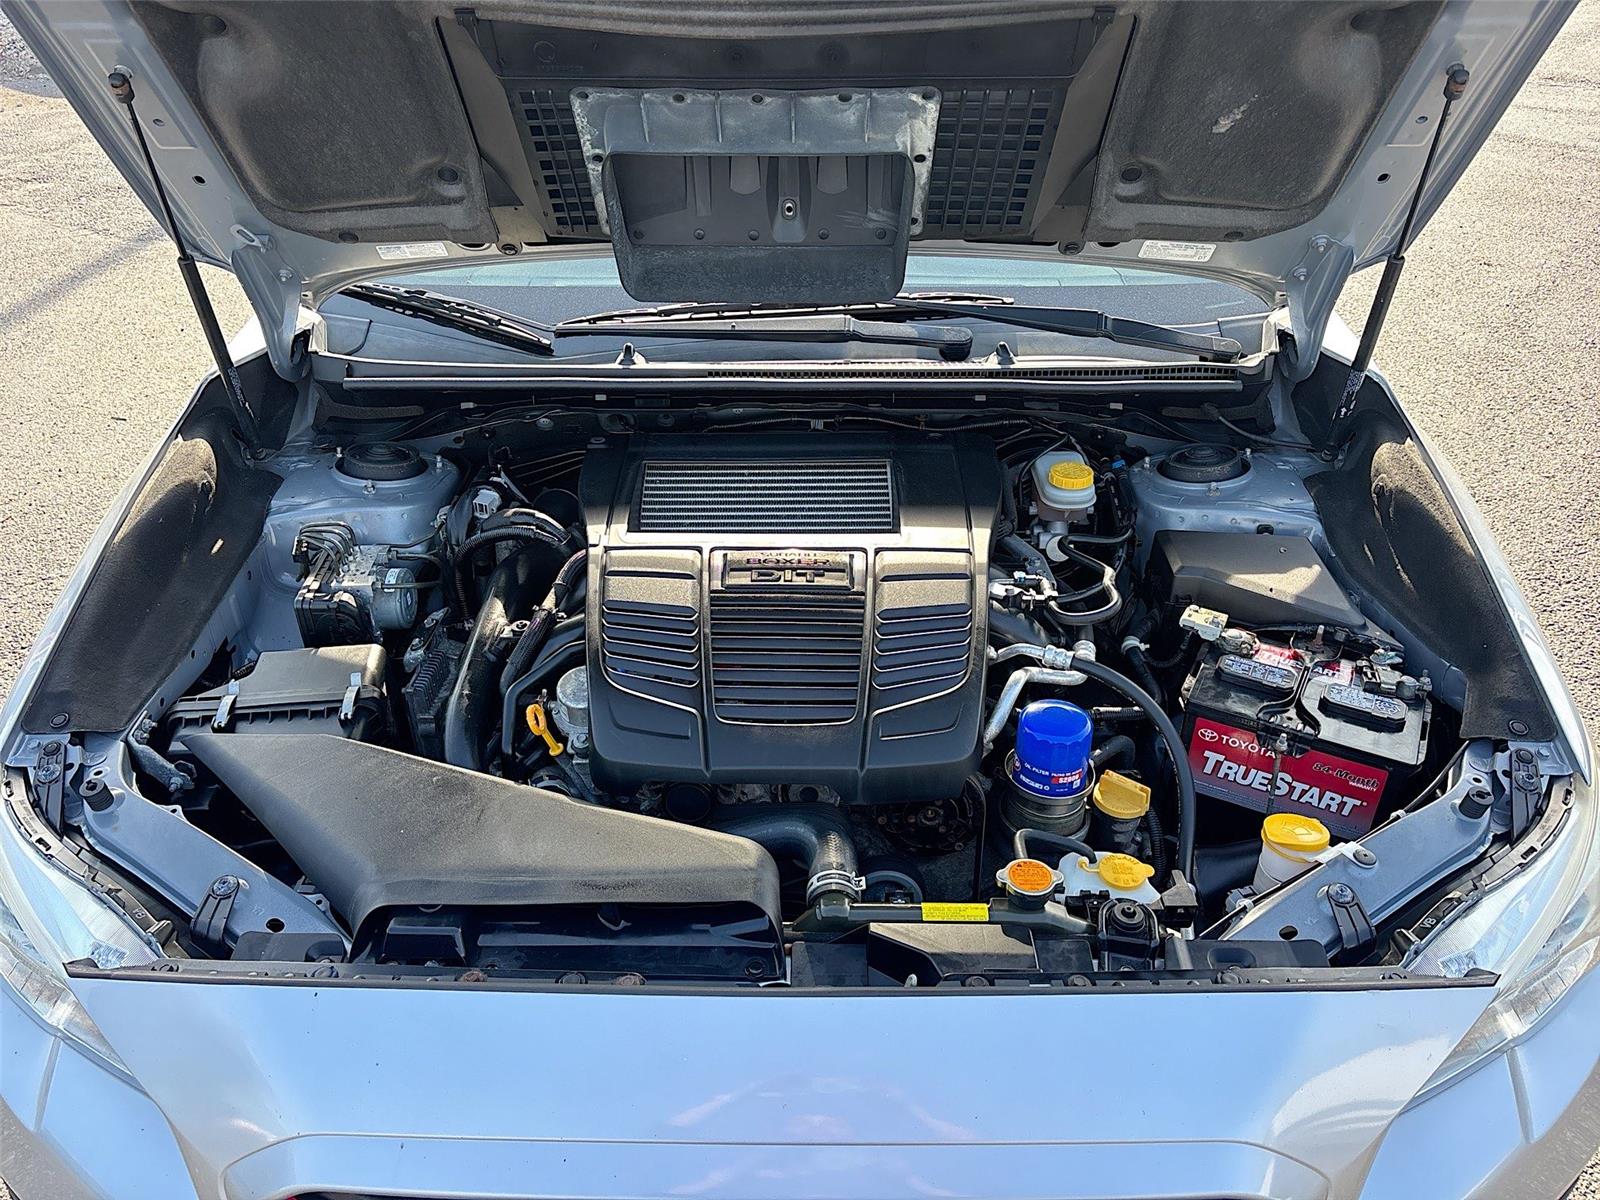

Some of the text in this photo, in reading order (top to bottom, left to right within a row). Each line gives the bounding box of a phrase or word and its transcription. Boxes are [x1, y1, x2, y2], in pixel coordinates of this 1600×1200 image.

[746, 558, 831, 566] BOXER
[750, 569, 826, 582] DIT
[1221, 734, 1276, 759] TOYOTA
[1032, 767, 1050, 776] FILTER
